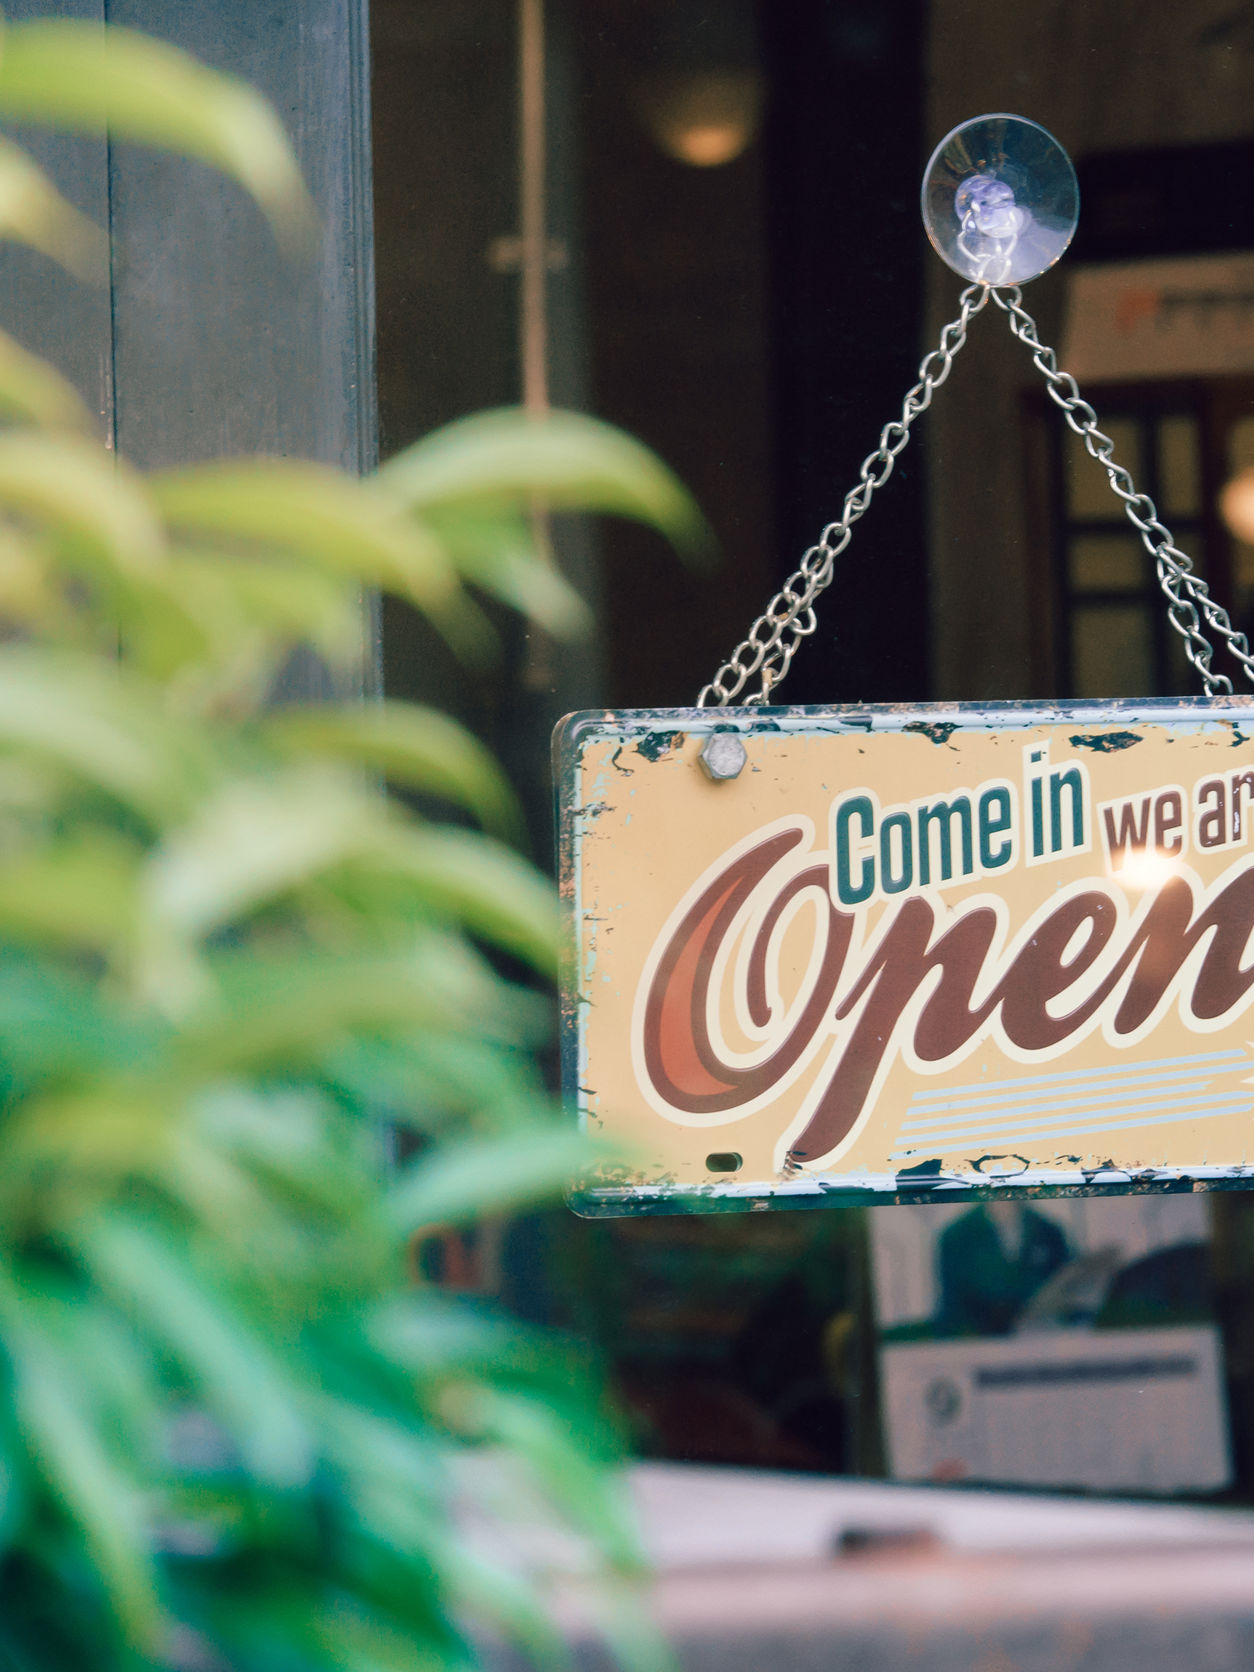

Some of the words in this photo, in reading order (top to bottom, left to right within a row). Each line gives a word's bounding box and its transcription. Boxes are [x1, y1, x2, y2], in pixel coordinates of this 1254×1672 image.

[836, 786, 1012, 905] Come
[1031, 749, 1085, 857] in
[1103, 788, 1183, 870] we
